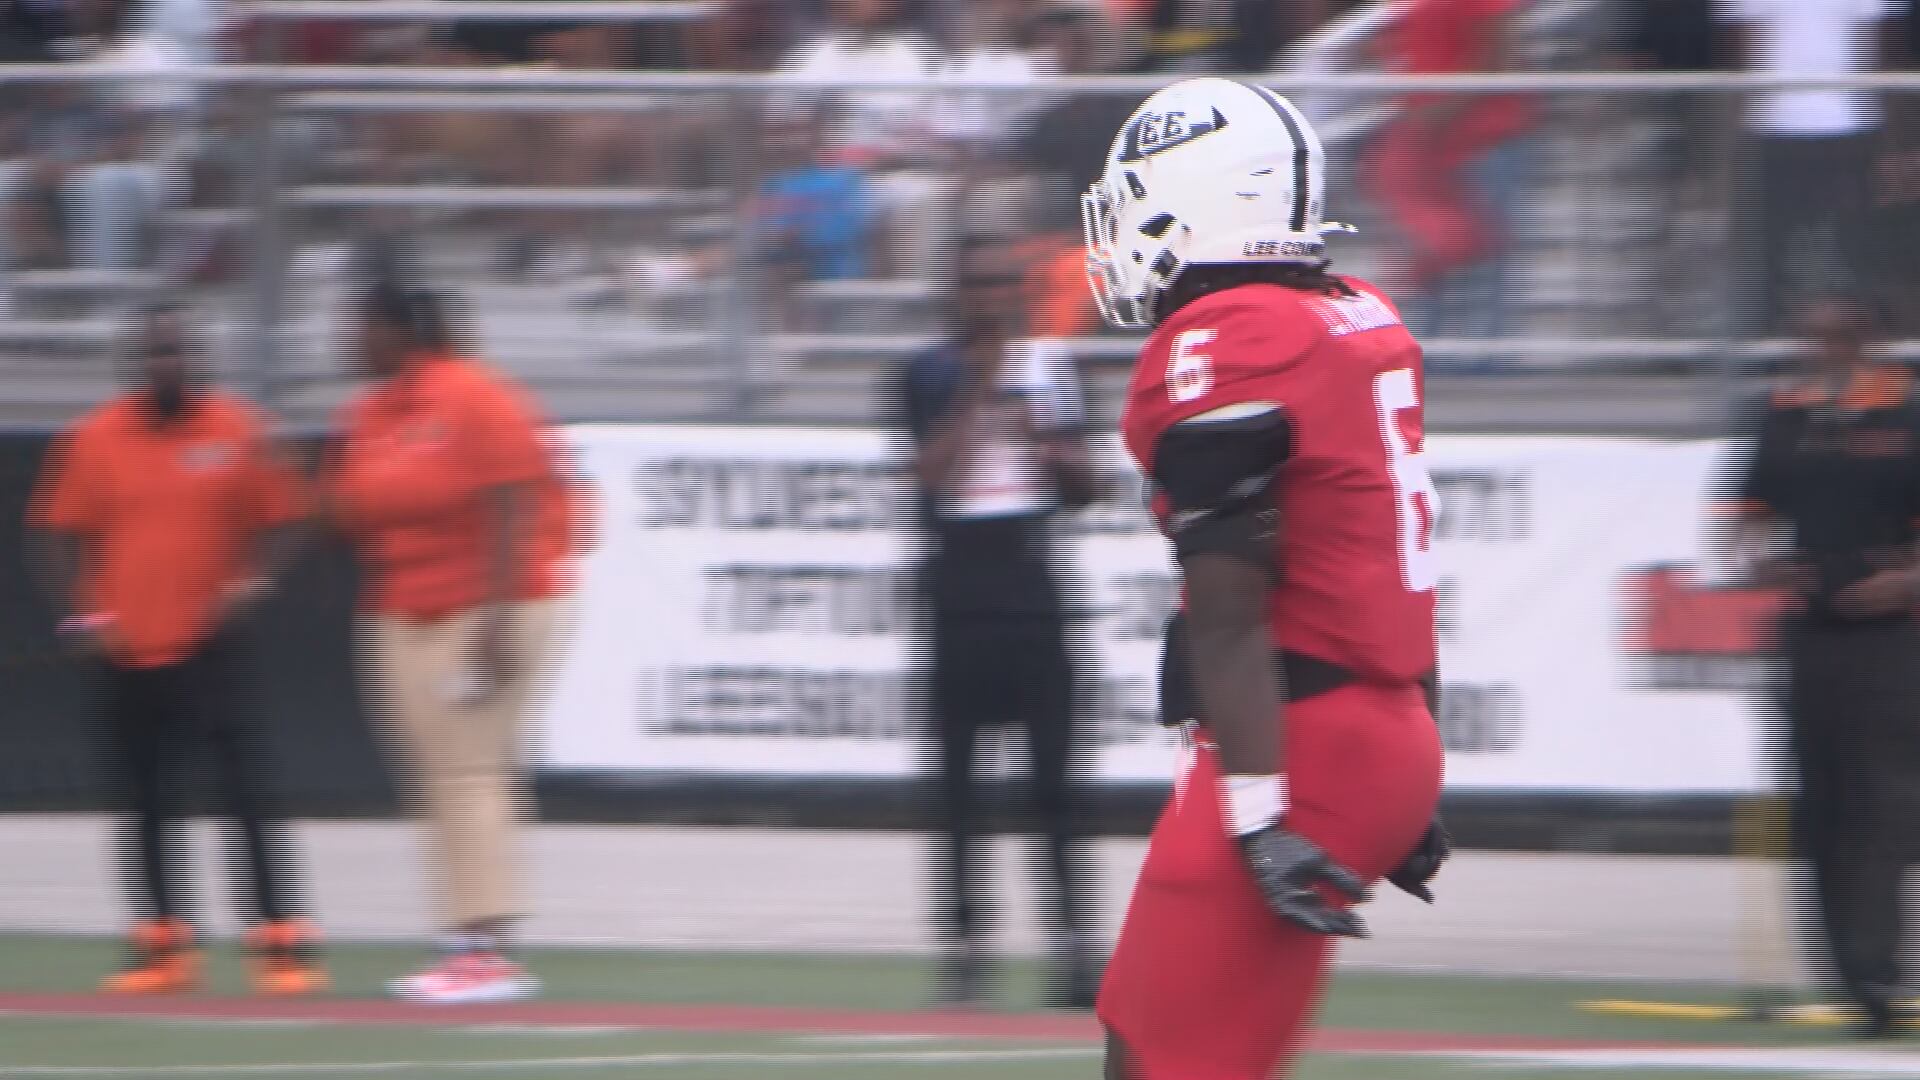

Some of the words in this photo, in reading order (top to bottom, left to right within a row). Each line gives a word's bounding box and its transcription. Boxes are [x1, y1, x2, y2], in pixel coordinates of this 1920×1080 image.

[1118, 106, 1228, 162] LEE
[1243, 239, 1280, 257] LEE
[1165, 329, 1219, 404] 6
[1372, 367, 1442, 592] 6
